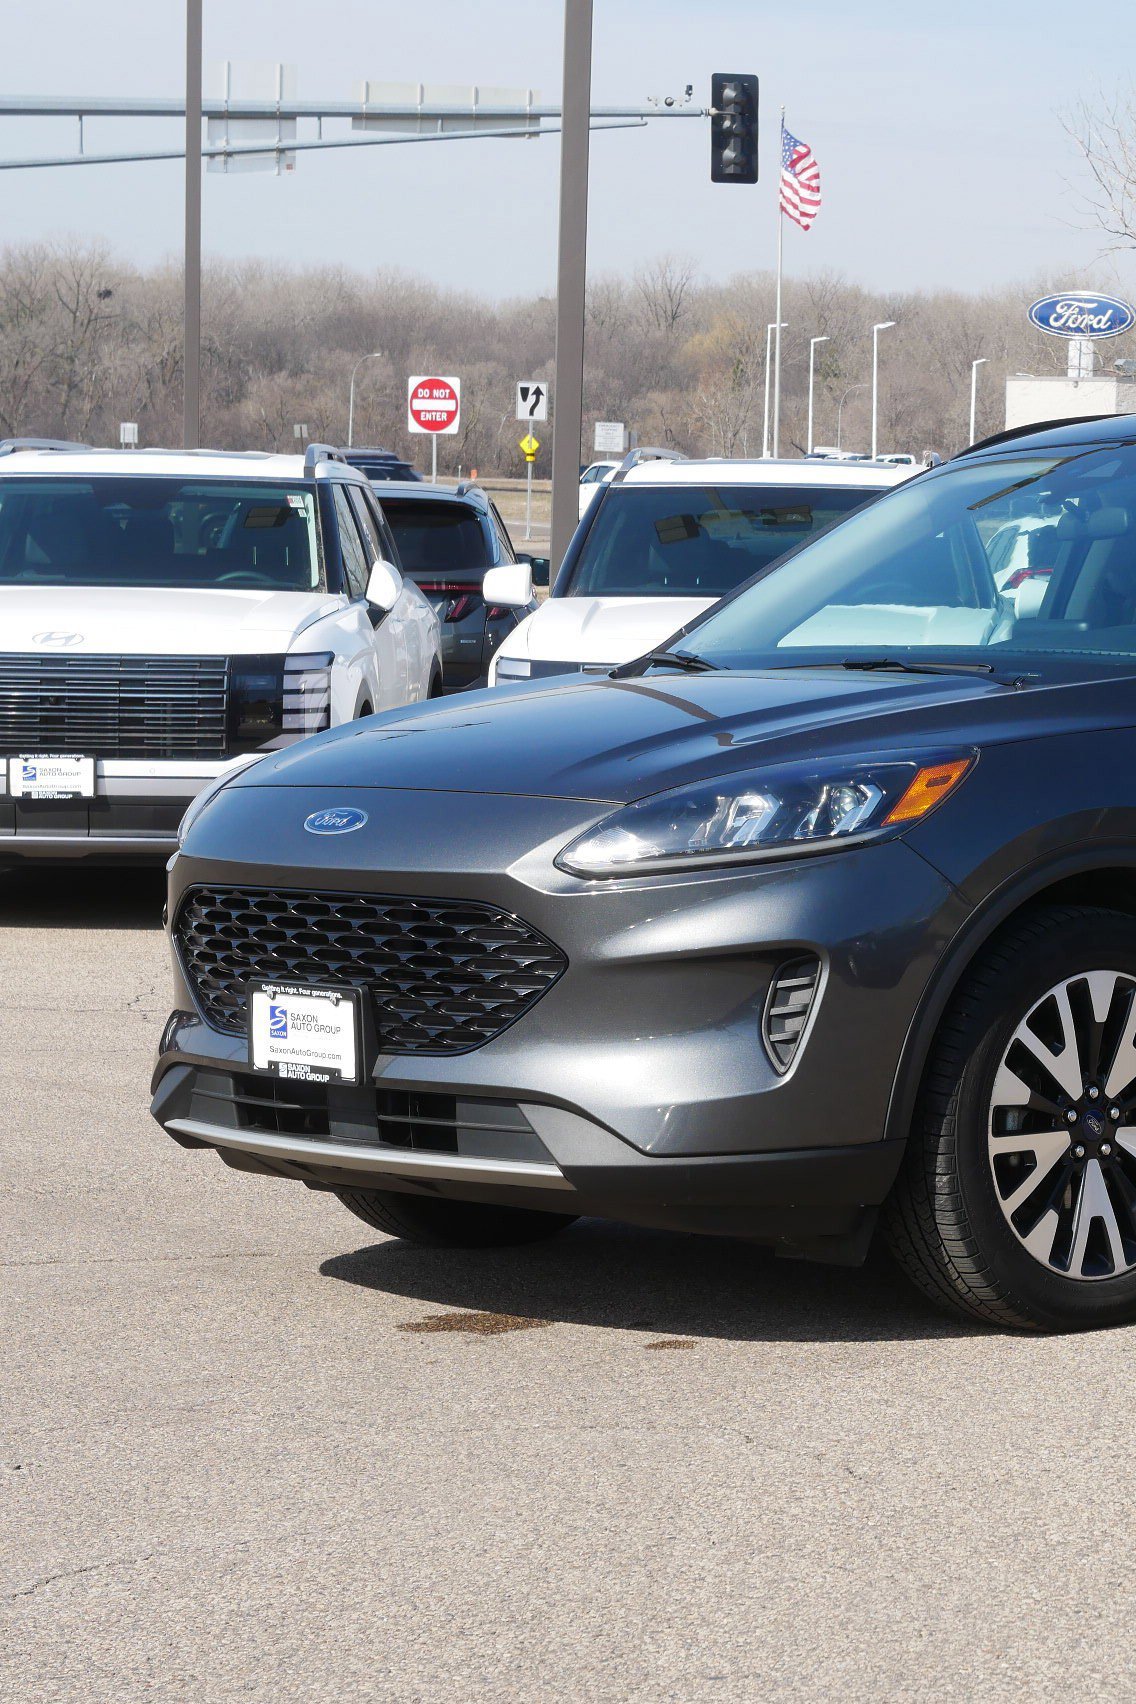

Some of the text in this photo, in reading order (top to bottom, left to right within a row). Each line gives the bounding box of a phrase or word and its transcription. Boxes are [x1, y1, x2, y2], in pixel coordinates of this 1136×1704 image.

[1049, 300, 1113, 329] Ford
[417, 388, 450, 398] DO NOT
[420, 411, 447, 422] ENTER
[315, 811, 353, 827] Ford
[261, 984, 281, 994] Getting
[299, 987, 311, 995] Four
[290, 1012, 318, 1023] SAXON
[290, 1022, 341, 1034] AUTO GROUP
[269, 1045, 342, 1061] SaxonAutoGroup.com
[287, 1062, 311, 1072] SAXON
[287, 1071, 330, 1083] AUTO GROUP
